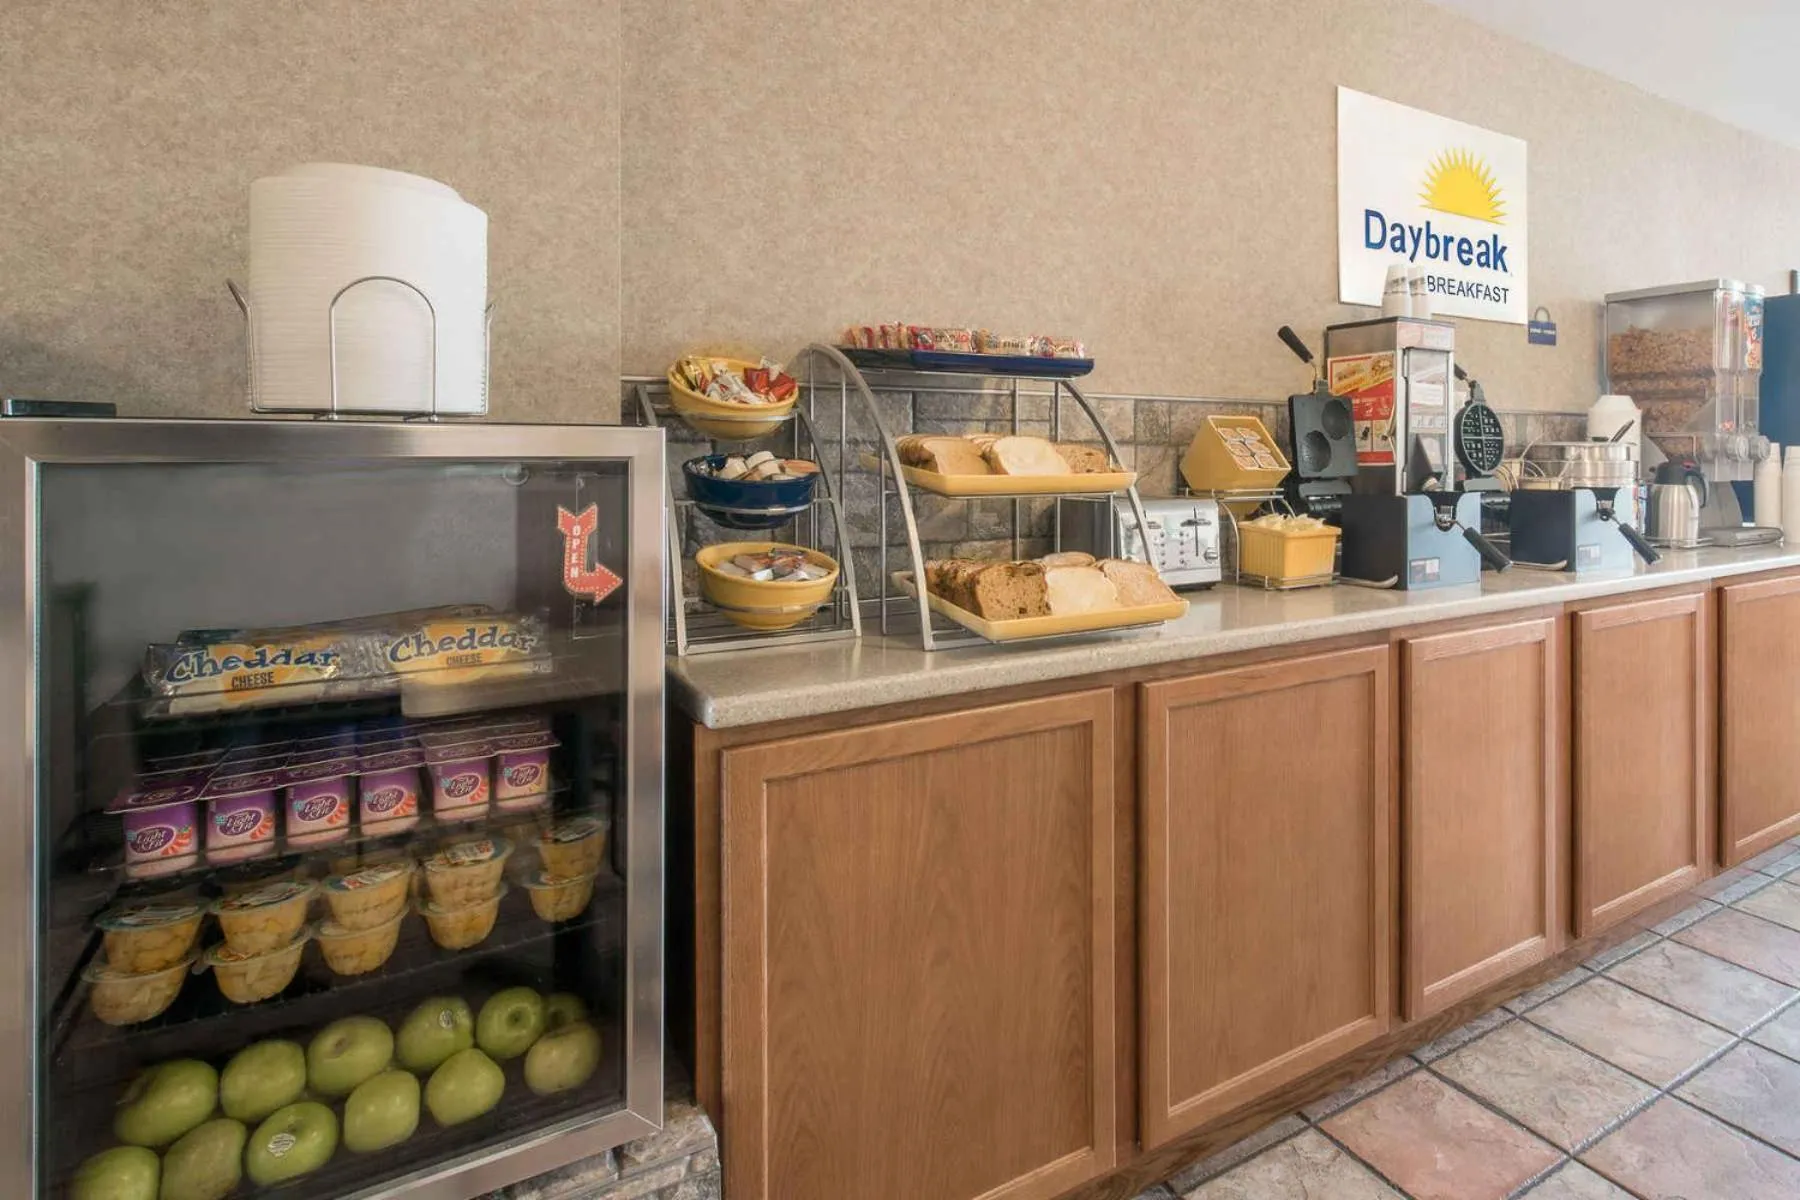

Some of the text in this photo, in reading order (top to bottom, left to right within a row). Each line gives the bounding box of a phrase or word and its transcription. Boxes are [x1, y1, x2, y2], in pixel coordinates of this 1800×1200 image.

[1364, 208, 1508, 273] Daybreak
[1427, 274, 1510, 305] BREAKFAST
[571, 525, 581, 578] OPEN
[387, 625, 537, 663] Cheddar
[446, 652, 483, 666] CHEESE
[165, 648, 339, 683] Cheddar
[231, 671, 275, 691] CHEESE
